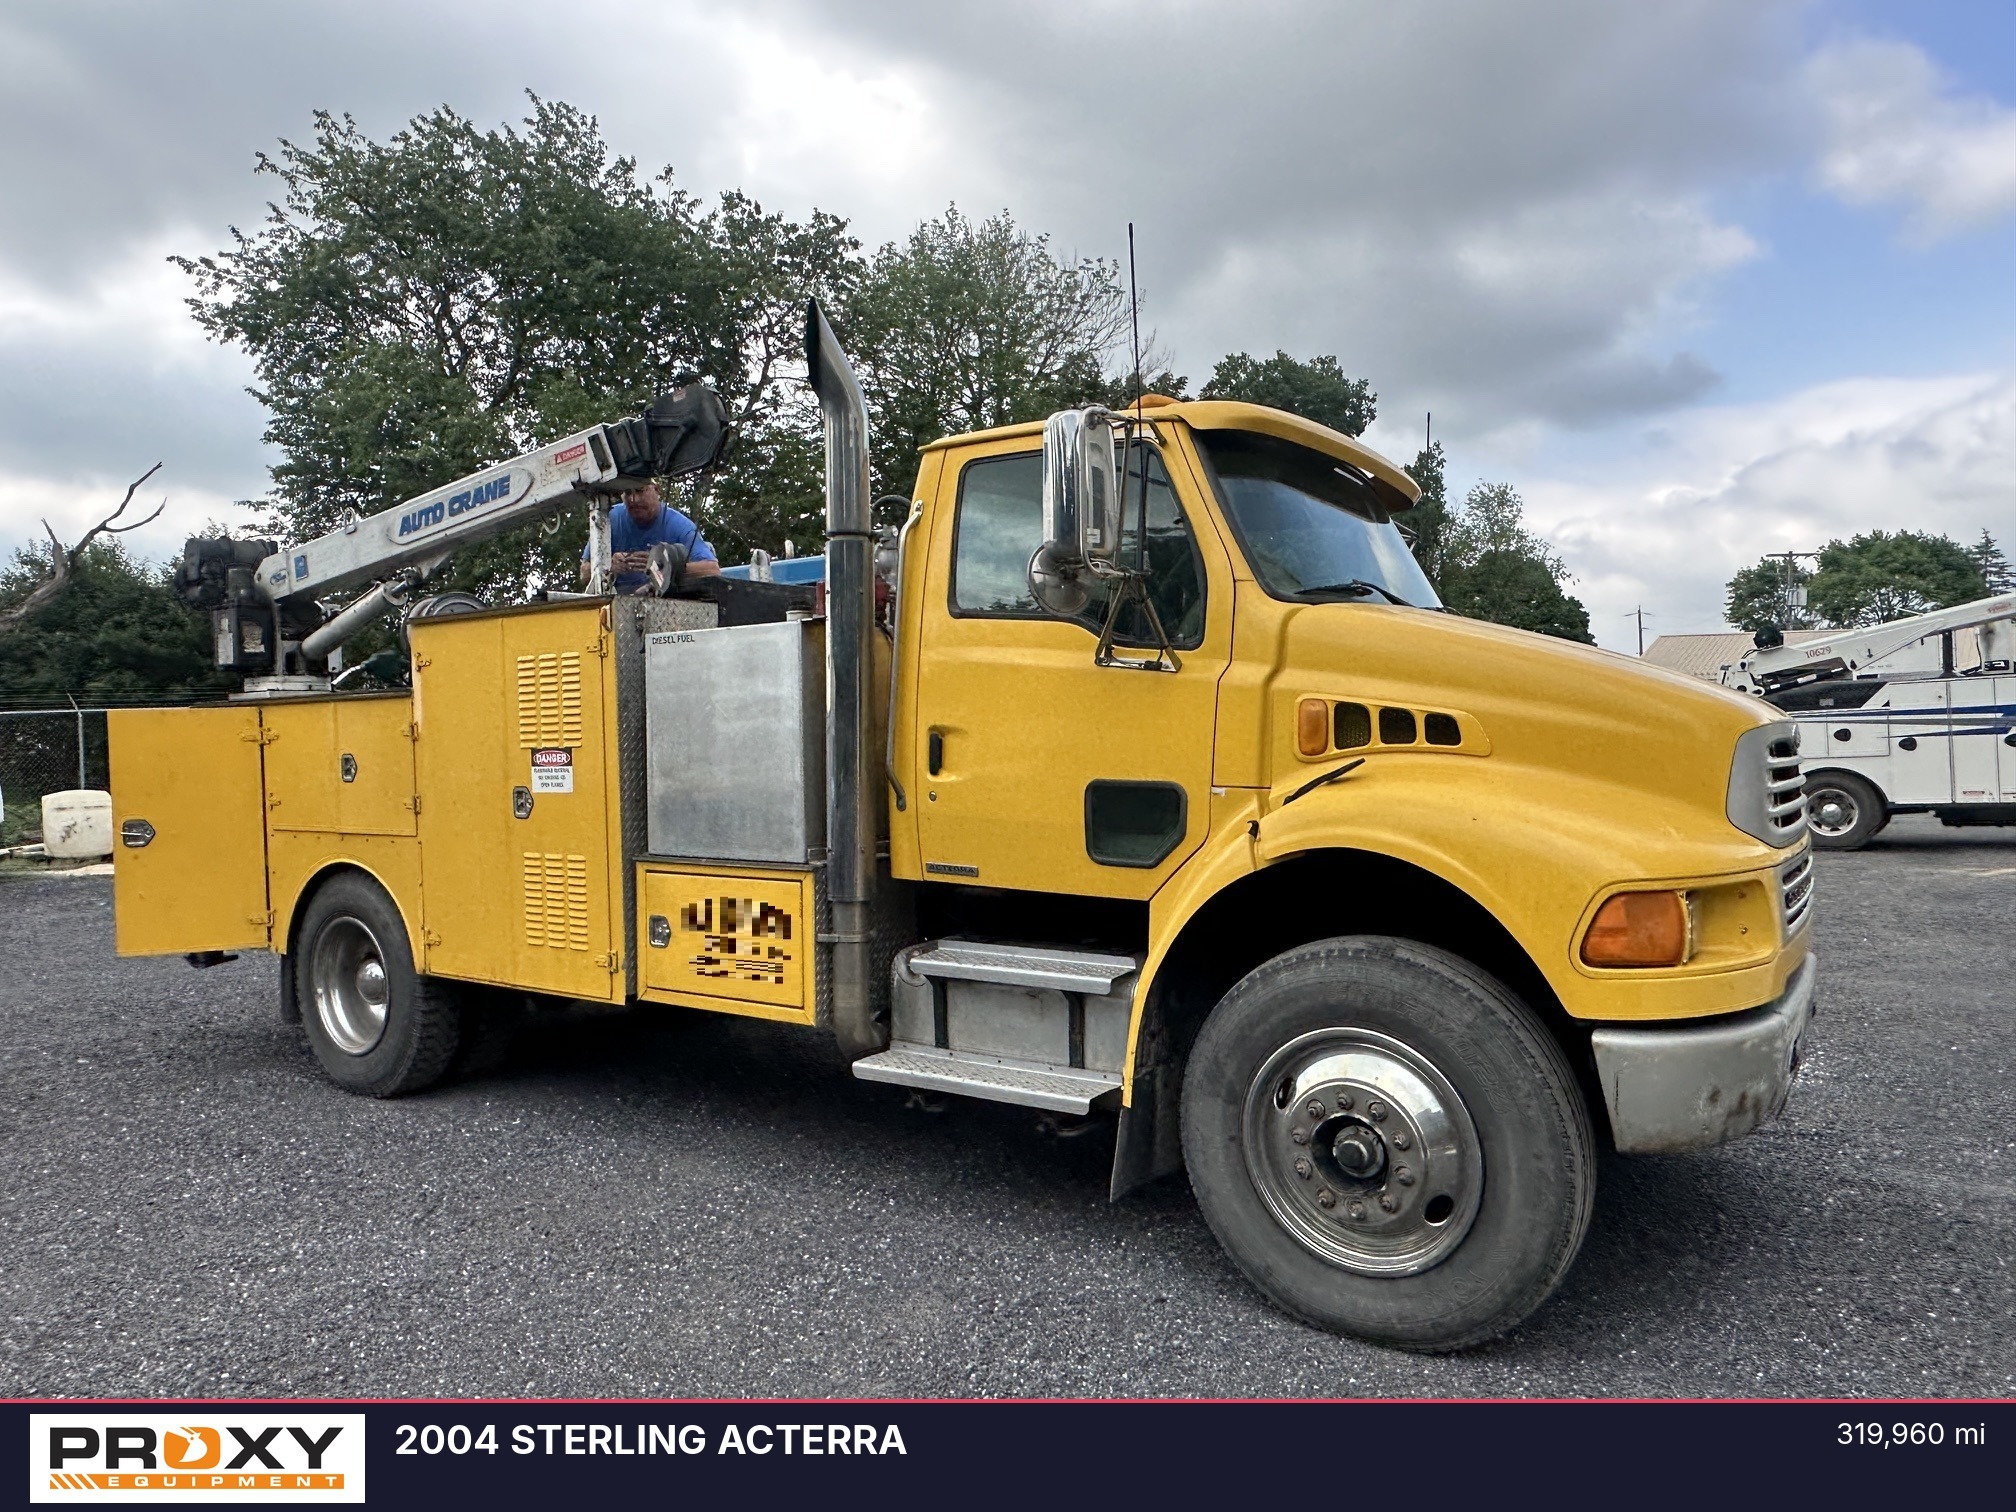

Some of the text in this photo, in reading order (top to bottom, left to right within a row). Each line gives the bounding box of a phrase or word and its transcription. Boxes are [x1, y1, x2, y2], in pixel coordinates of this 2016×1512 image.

[399, 474, 511, 537] AUTO CRANE
[677, 634, 695, 643] FUEL
[1805, 645, 1832, 659] 10629
[536, 753, 568, 764] DANGER
